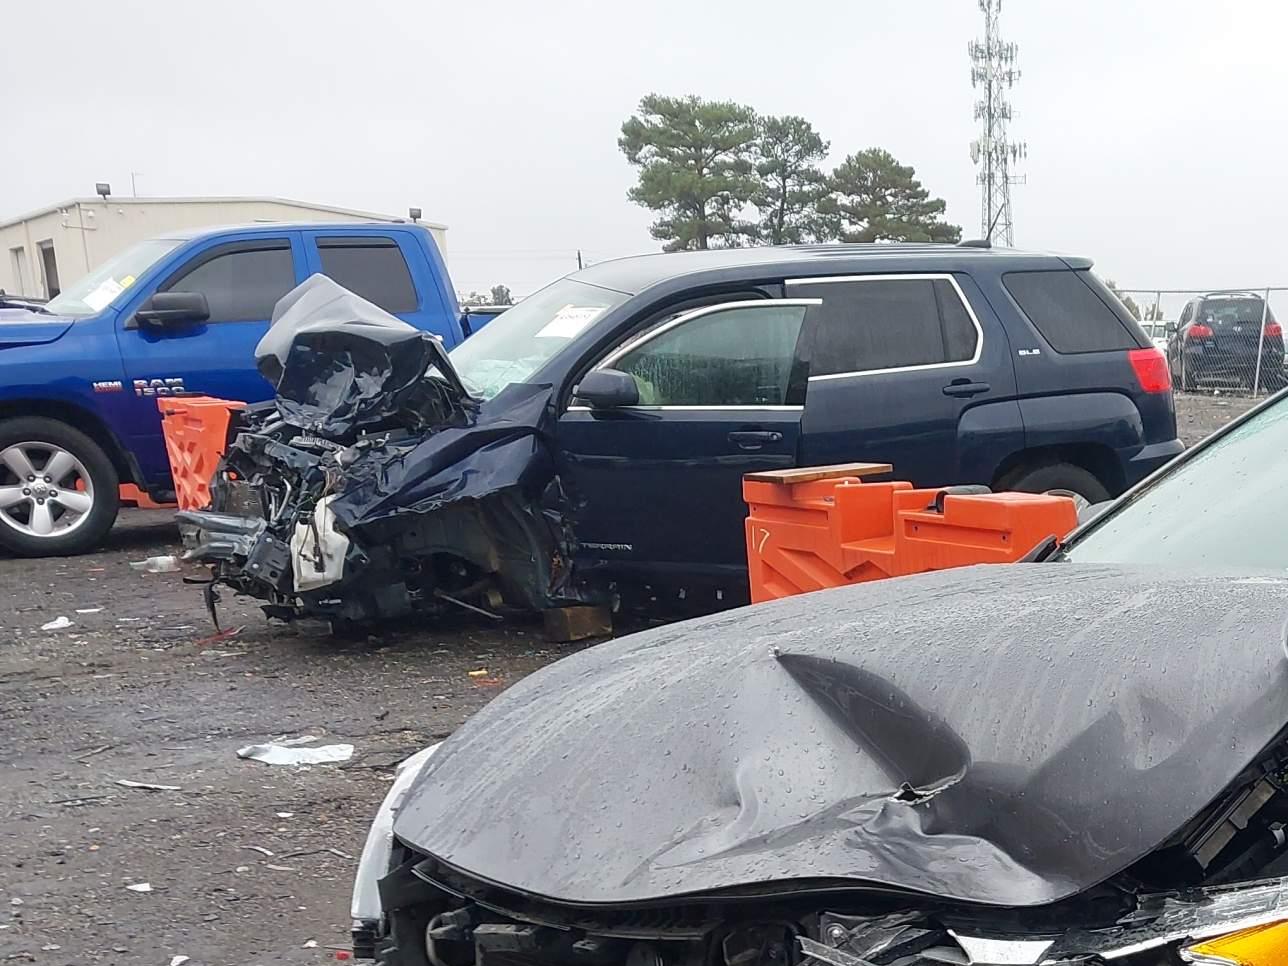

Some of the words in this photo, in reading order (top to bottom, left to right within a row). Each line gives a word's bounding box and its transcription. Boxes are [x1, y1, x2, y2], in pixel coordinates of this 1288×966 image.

[92, 381, 123, 389] HEMI
[133, 378, 184, 388] RAM
[135, 387, 185, 397] 1500
[751, 524, 770, 554] 17
